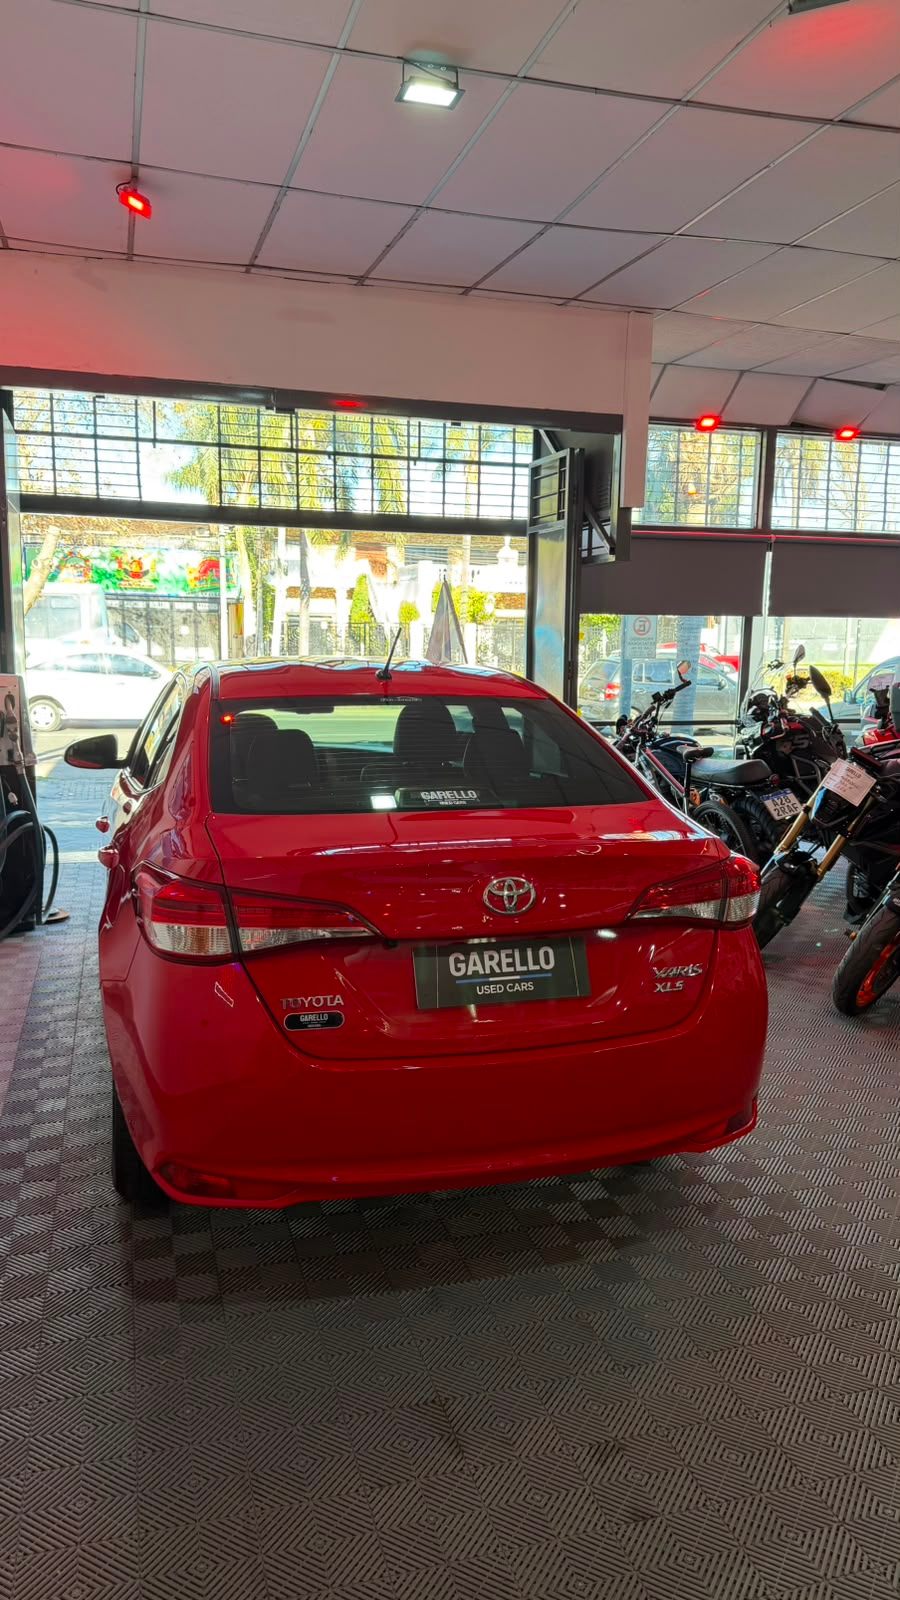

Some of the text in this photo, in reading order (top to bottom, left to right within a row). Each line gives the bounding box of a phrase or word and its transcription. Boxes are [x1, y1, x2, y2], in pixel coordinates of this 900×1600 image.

[420, 790, 477, 800] GARELLO
[449, 946, 555, 977] GARELLO
[653, 963, 703, 979] YARIS
[476, 982, 535, 995] USED CARS
[653, 980, 684, 993] XLS
[280, 995, 345, 1010] TOYOTA
[300, 1013, 329, 1022] GARELLO
